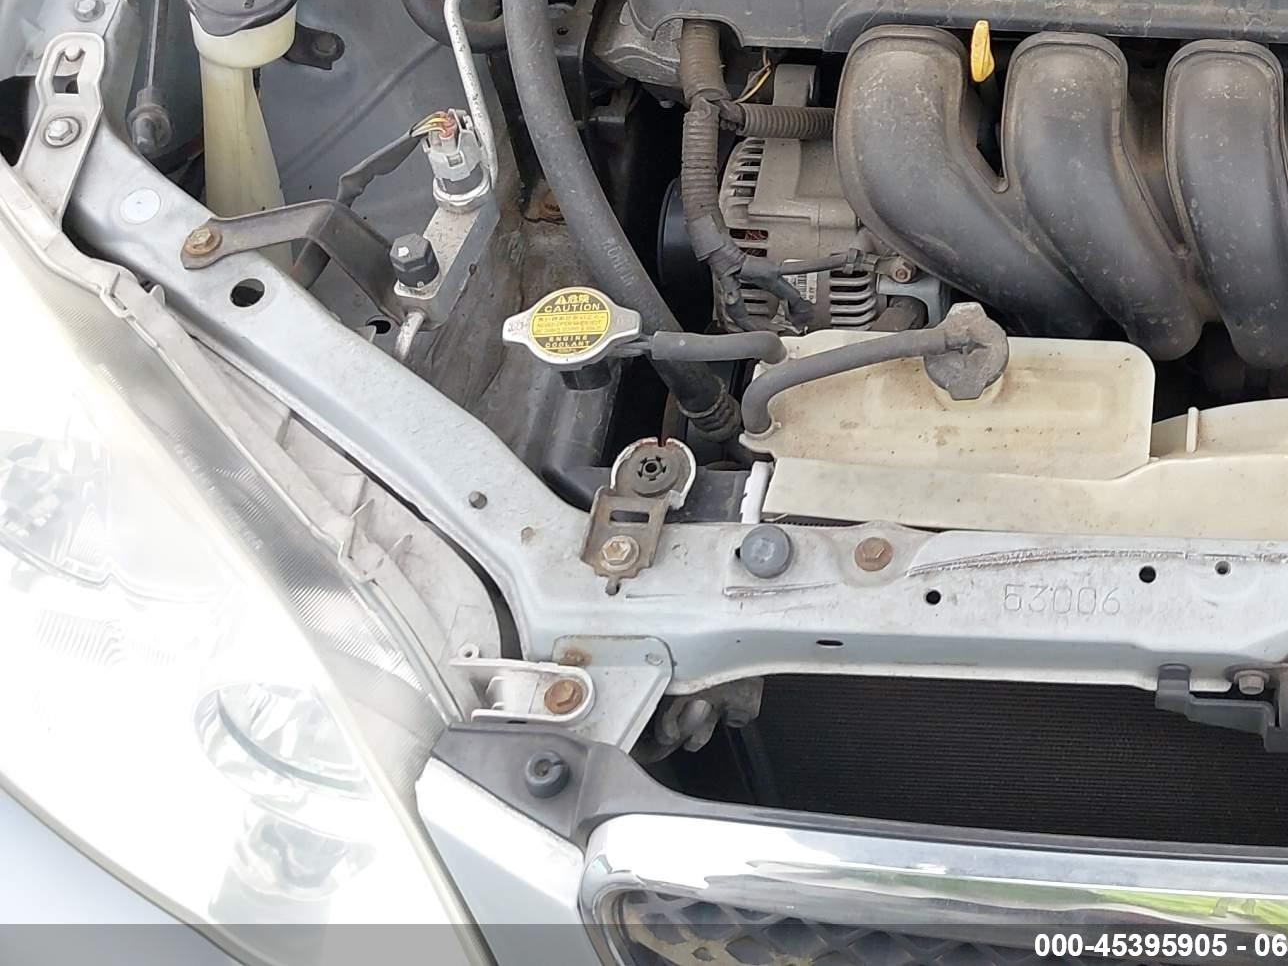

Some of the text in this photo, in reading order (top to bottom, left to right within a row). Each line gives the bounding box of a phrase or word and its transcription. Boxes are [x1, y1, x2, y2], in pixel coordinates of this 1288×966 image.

[544, 302, 601, 313] CAUTION
[544, 340, 591, 348] COOLANT
[1003, 583, 1121, 616] 53006
